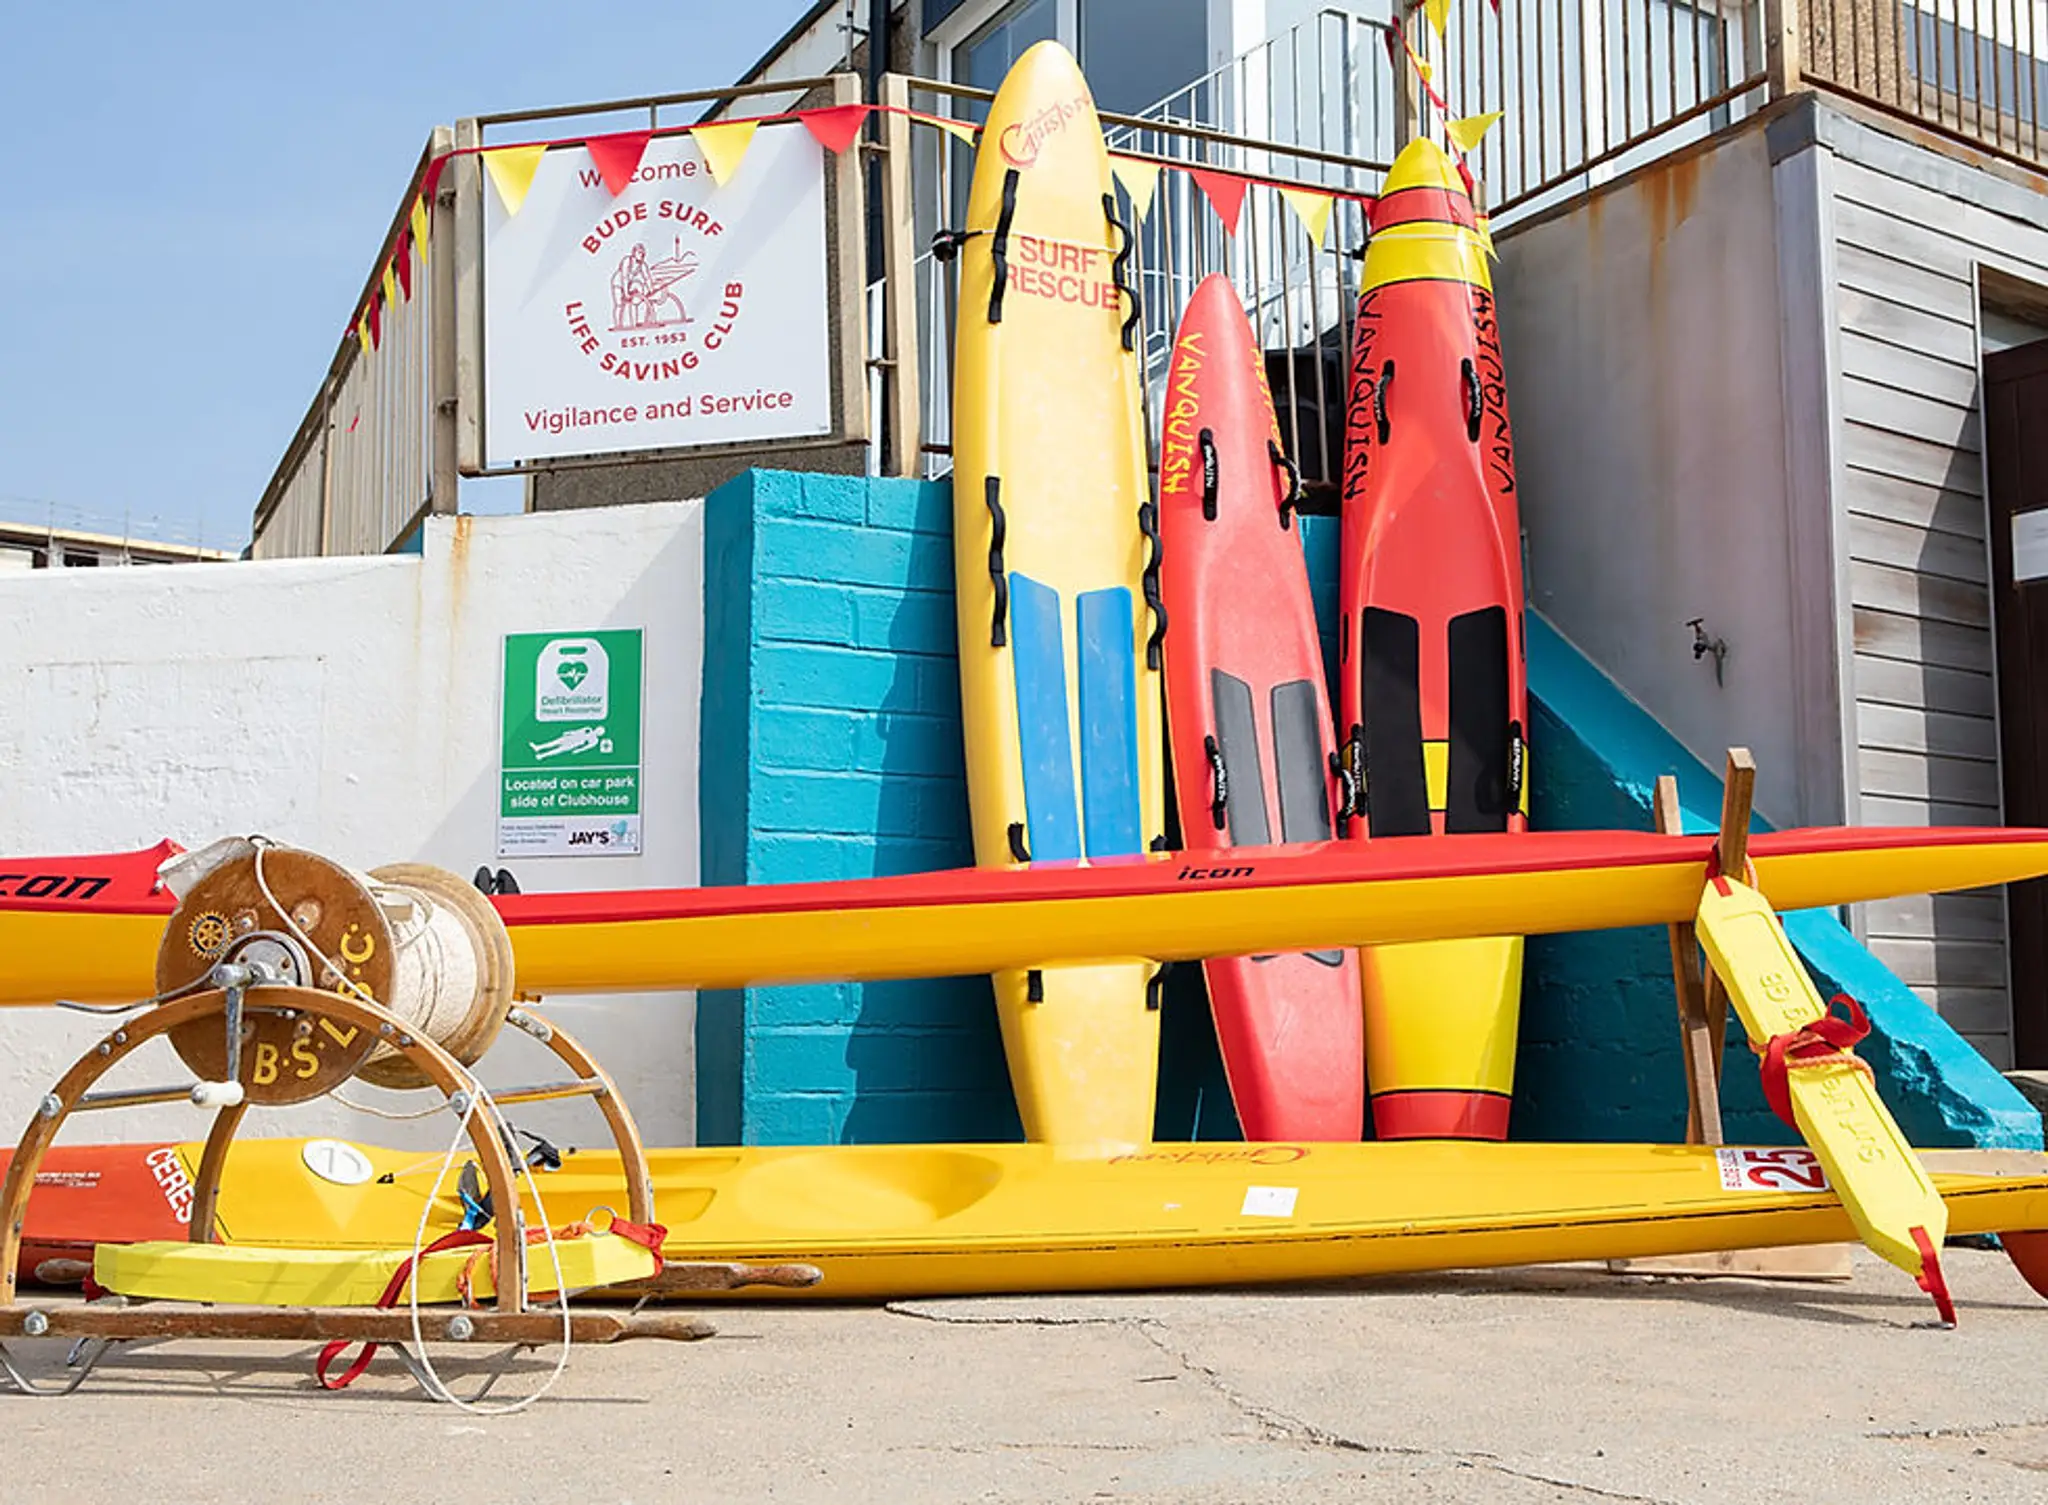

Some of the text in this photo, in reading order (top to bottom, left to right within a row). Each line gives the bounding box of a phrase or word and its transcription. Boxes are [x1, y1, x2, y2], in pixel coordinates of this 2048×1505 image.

[579, 160, 697, 188] Wcome
[582, 200, 723, 254] BUDE SURF
[1020, 235, 1099, 273] SURF
[1007, 263, 1120, 310] RESCUE
[565, 281, 743, 381] LIFE SAVING CLUB
[621, 332, 686, 348] EST. 1953
[524, 388, 794, 434] Vigilance and Service
[1162, 332, 1207, 494] VANQUISH
[1344, 293, 1382, 500] VANQUISH
[505, 776, 635, 791] Located on car park
[511, 793, 629, 808] side of Clubhouse
[568, 831, 610, 845] JAY'S
[1178, 865, 1255, 880] icon
[146, 1148, 195, 1224] CERES
[1743, 1149, 1826, 1189] 25
